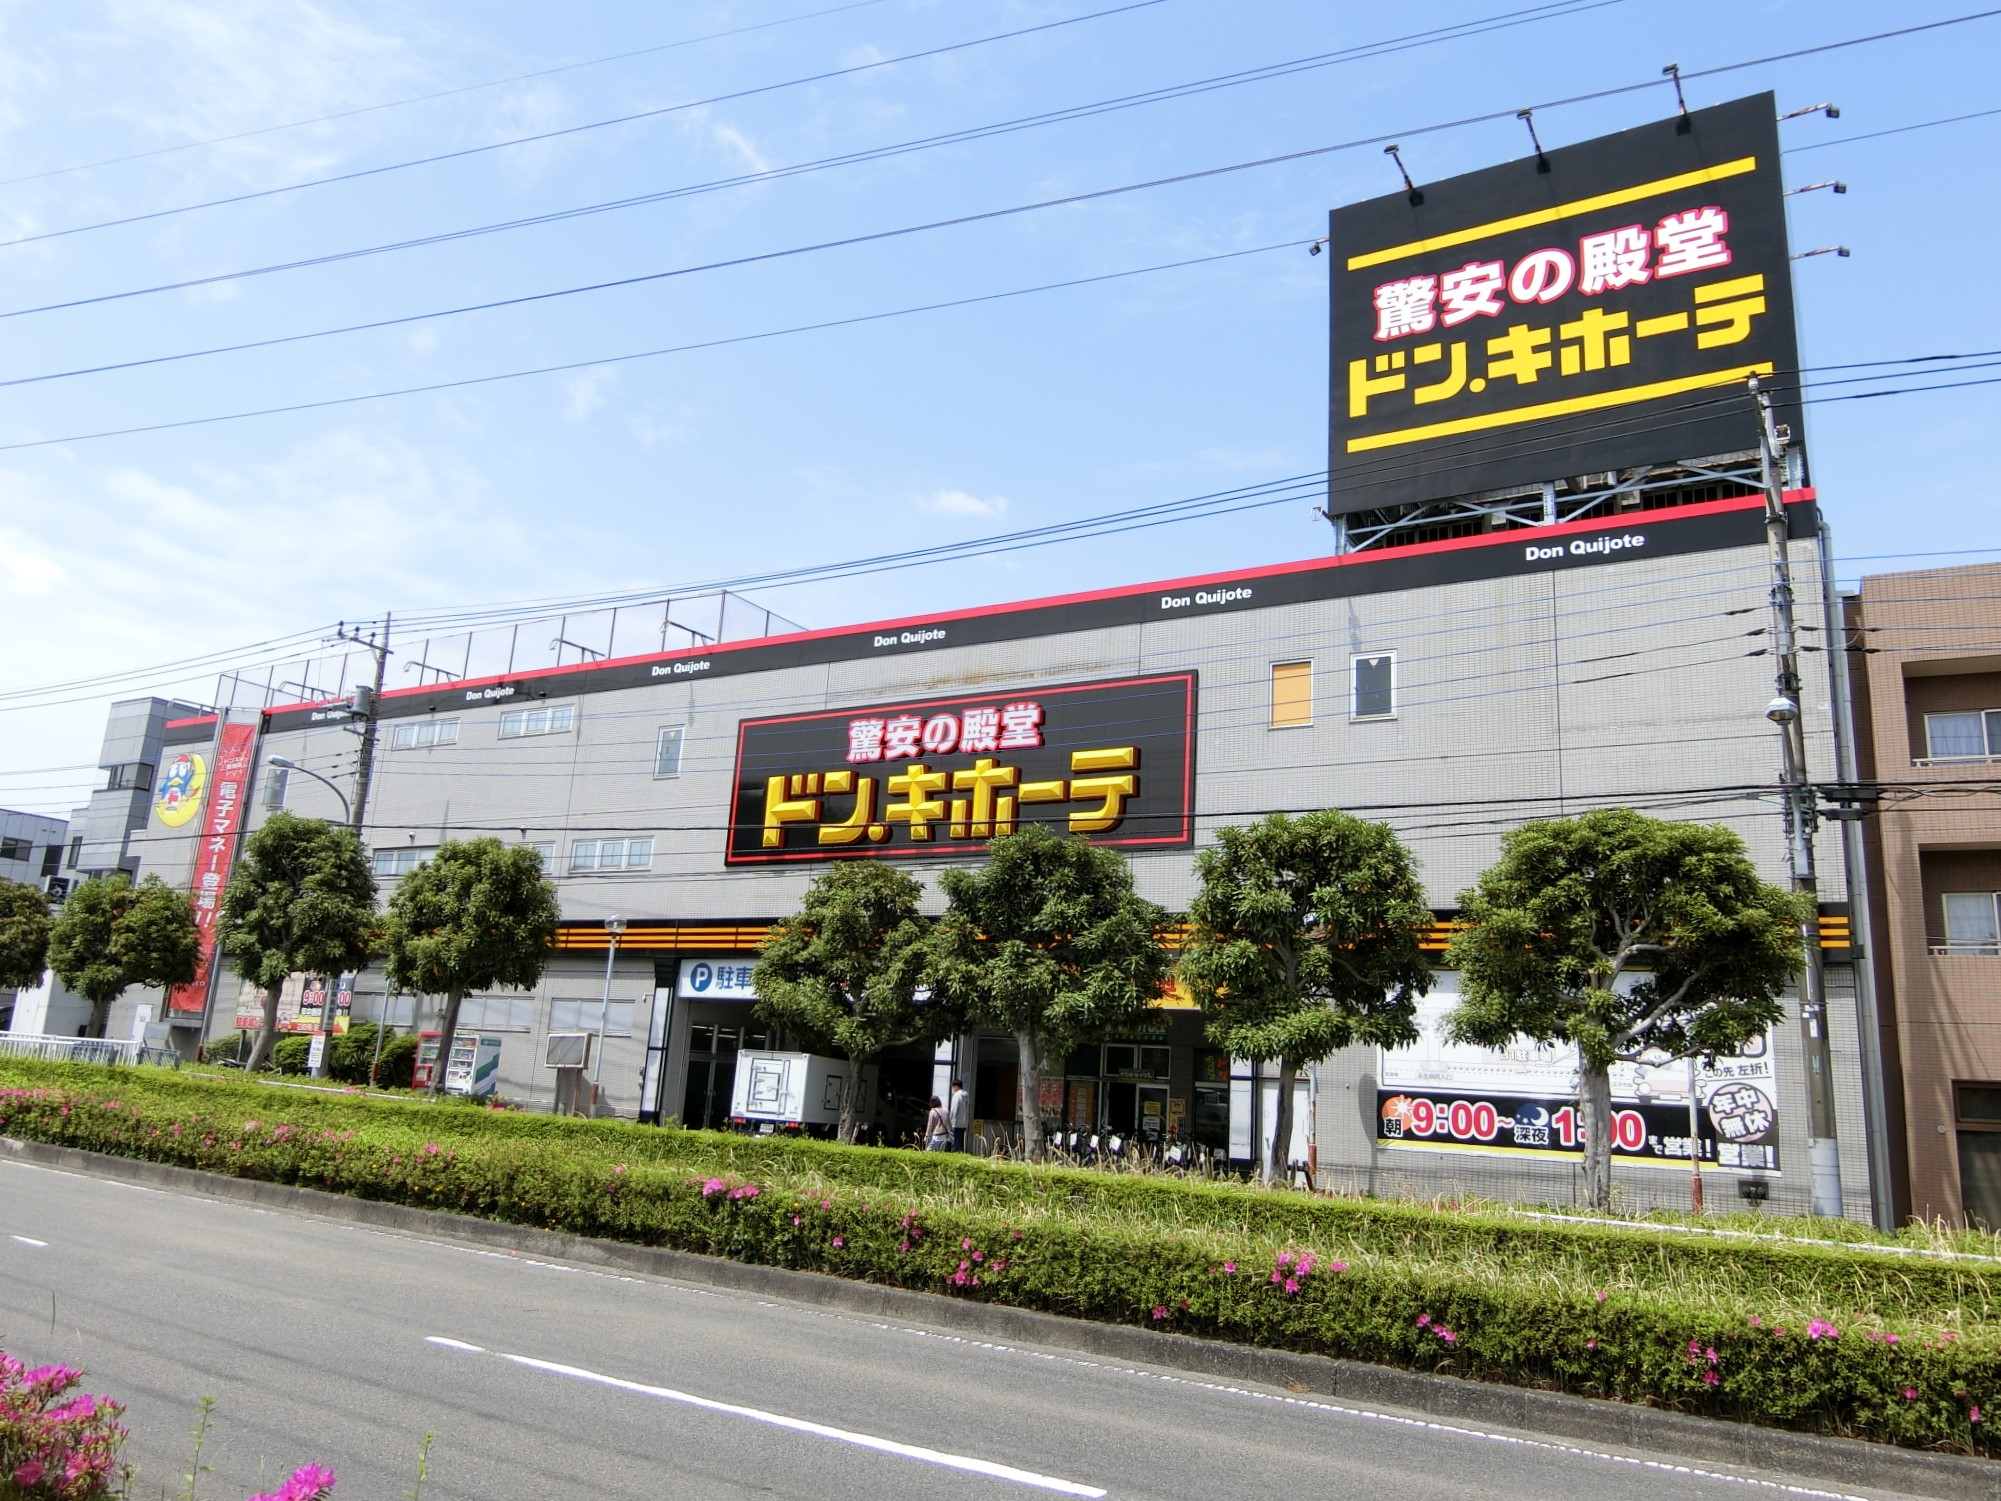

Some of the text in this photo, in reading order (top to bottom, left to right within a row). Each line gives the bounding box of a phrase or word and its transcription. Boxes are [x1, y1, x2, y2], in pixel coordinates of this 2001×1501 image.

[1375, 206, 1731, 341] 驚安の殿堂
[1525, 532, 1645, 562] Don Quijote
[1161, 587, 1253, 609] Don Quijote
[873, 628, 946, 647] Don Quijote
[652, 660, 710, 676] Don Quijote
[465, 686, 515, 701] Don Quijote
[311, 711, 326, 721] Don
[846, 701, 1046, 764] 驚安の殿堂
[1713, 1087, 1760, 1114] 年中
[1385, 1118, 1403, 1137] 朝
[1515, 1125, 1549, 1145] 深夜
[1719, 1110, 1770, 1139] 無休
[1717, 1142, 1775, 1169] 営業!
